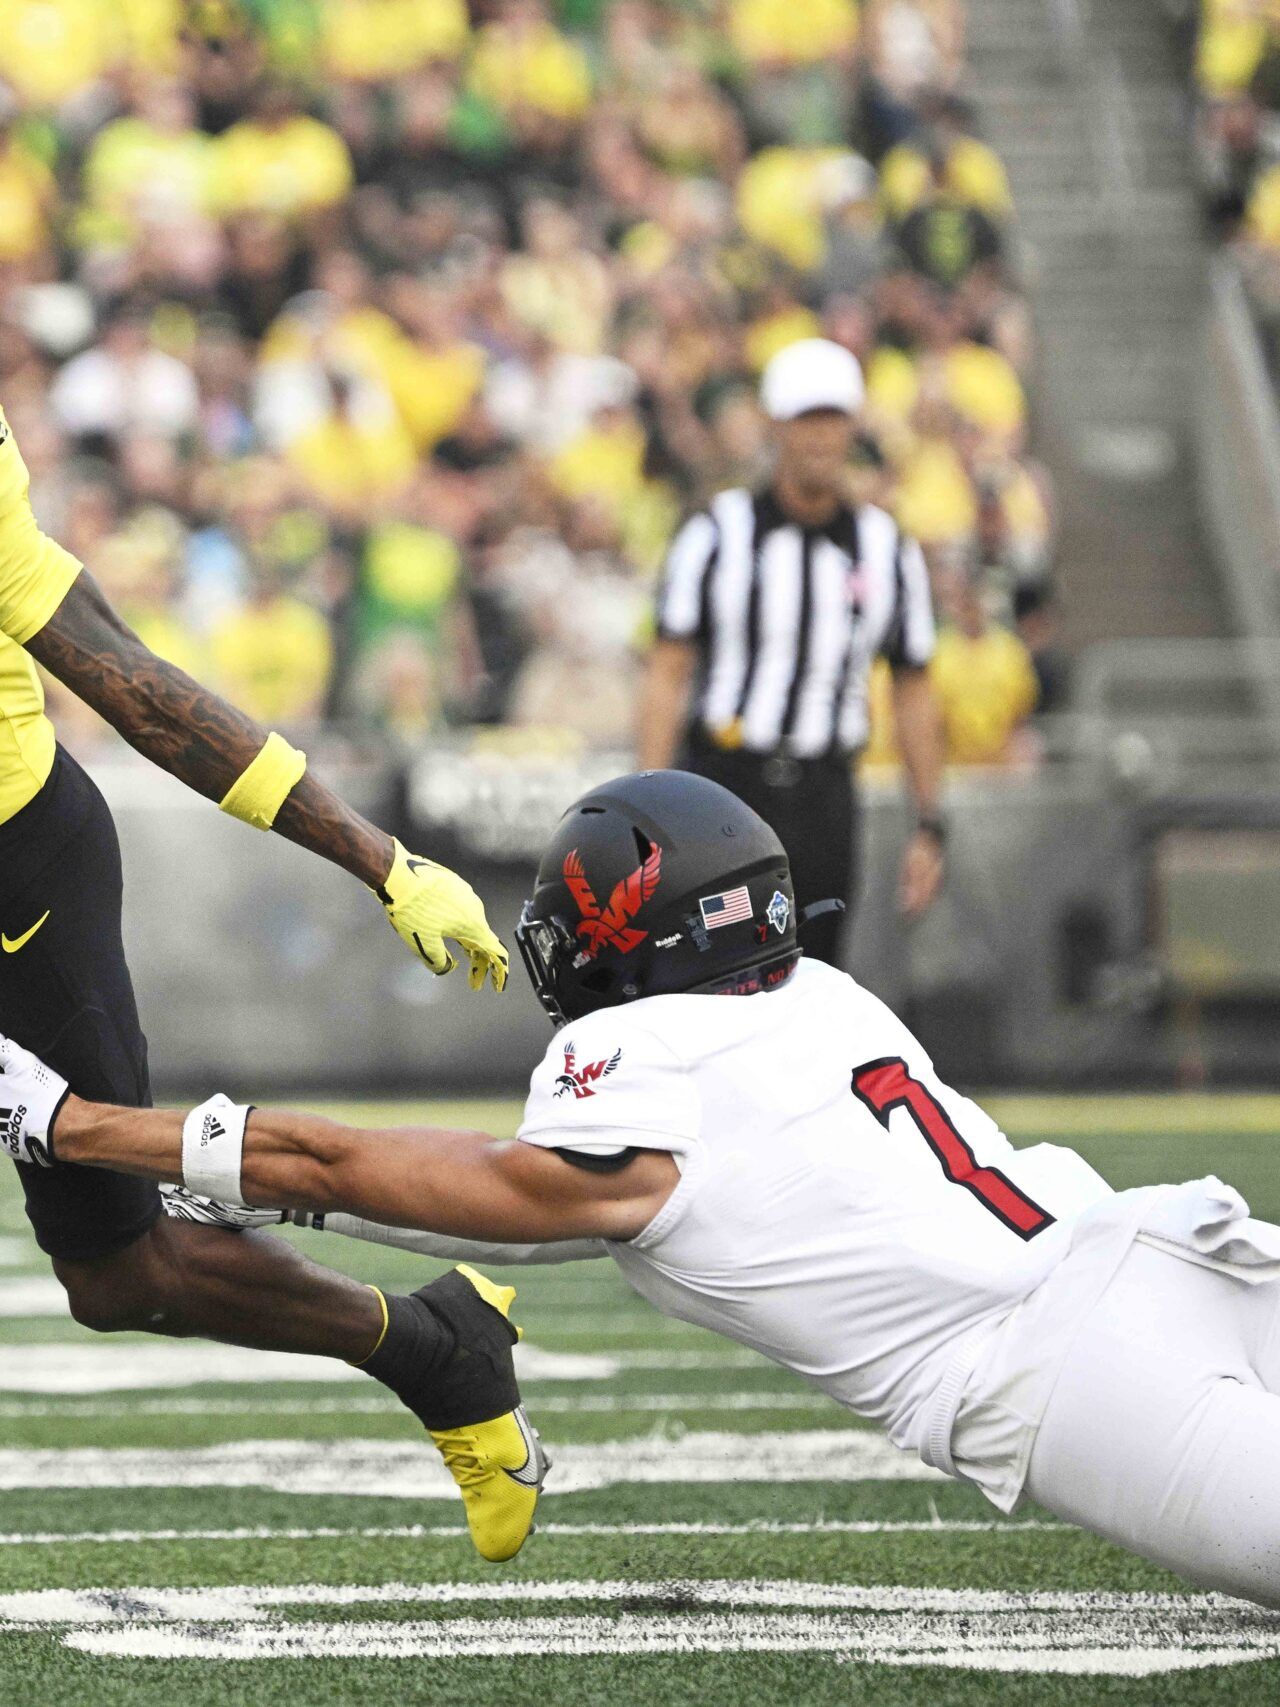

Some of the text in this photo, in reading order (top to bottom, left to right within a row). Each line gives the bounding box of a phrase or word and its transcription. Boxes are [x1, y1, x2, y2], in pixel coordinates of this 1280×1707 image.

[9, 1104, 27, 1154] adidas
[201, 1113, 212, 1147] adidas
[851, 1056, 1057, 1242] 7
